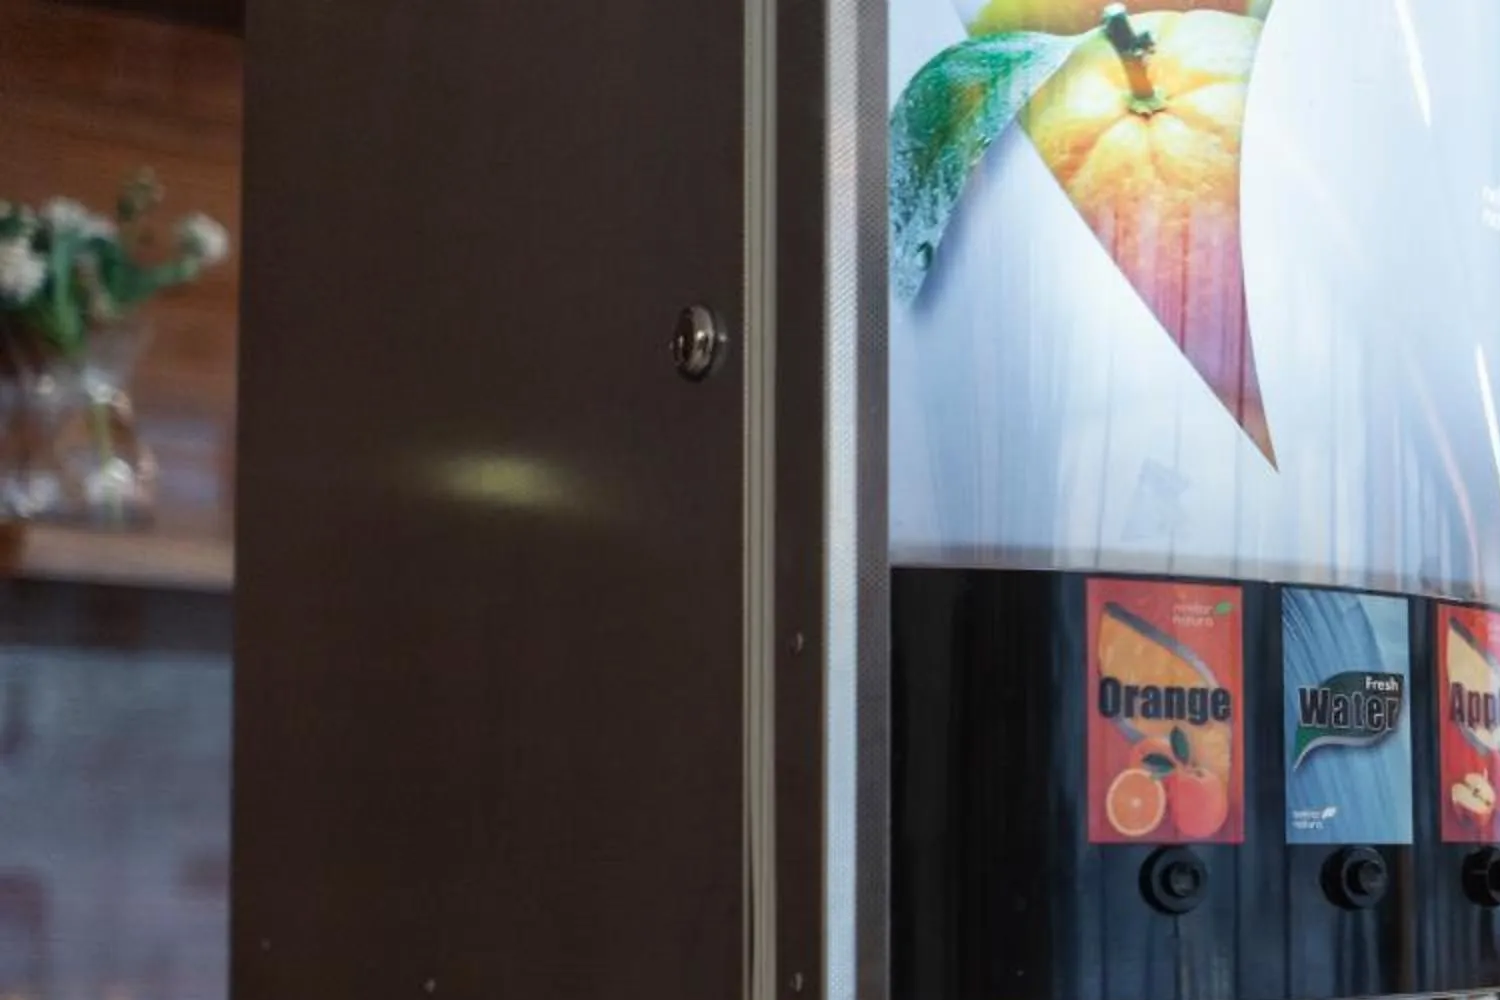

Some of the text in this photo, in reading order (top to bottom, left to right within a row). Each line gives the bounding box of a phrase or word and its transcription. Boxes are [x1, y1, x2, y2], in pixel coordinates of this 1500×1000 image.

[1098, 676, 1231, 726] Orange
[1365, 676, 1399, 691] Fresh
[1298, 686, 1399, 731] Water
